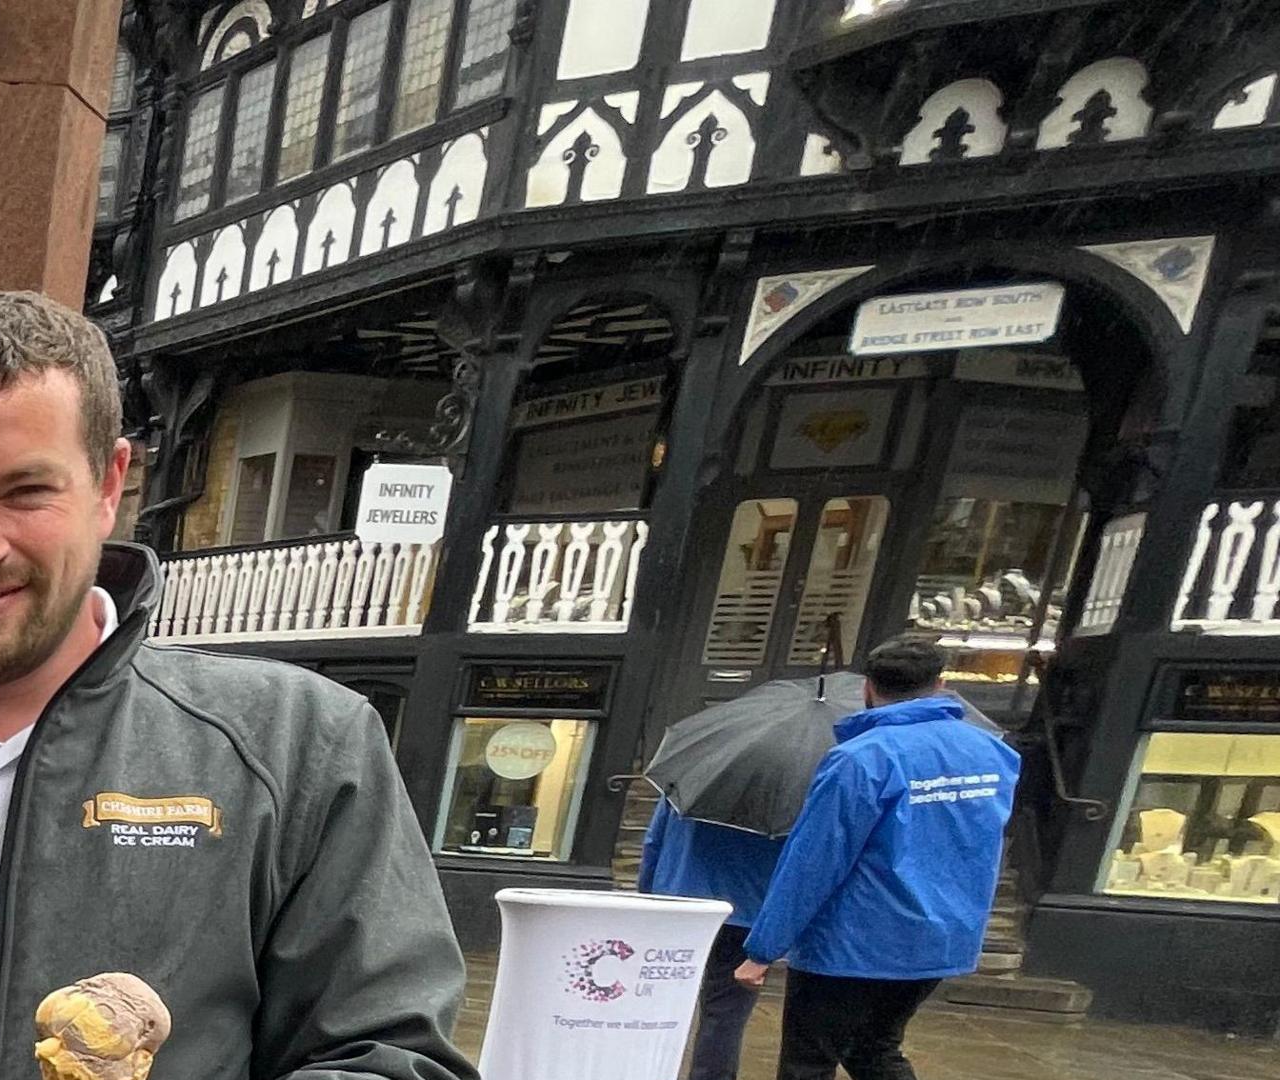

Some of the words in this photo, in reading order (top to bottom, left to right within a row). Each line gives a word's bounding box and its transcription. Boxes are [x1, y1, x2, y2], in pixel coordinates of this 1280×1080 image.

[878, 299, 948, 315] EASTGATE
[912, 329, 964, 344] STREET
[1005, 324, 1043, 338] EAST
[783, 357, 900, 379] INFINITY
[379, 483, 434, 499] INFINITY
[366, 509, 438, 525] JEWELLERS
[520, 747, 553, 760] OFF
[910, 776, 962, 791] Together
[111, 824, 149, 835] REAL
[152, 825, 198, 836] DAIRY
[114, 835, 136, 846] ICE
[140, 836, 195, 847] CREAM
[634, 983, 655, 997] UK
[553, 1015, 605, 1029] Together
